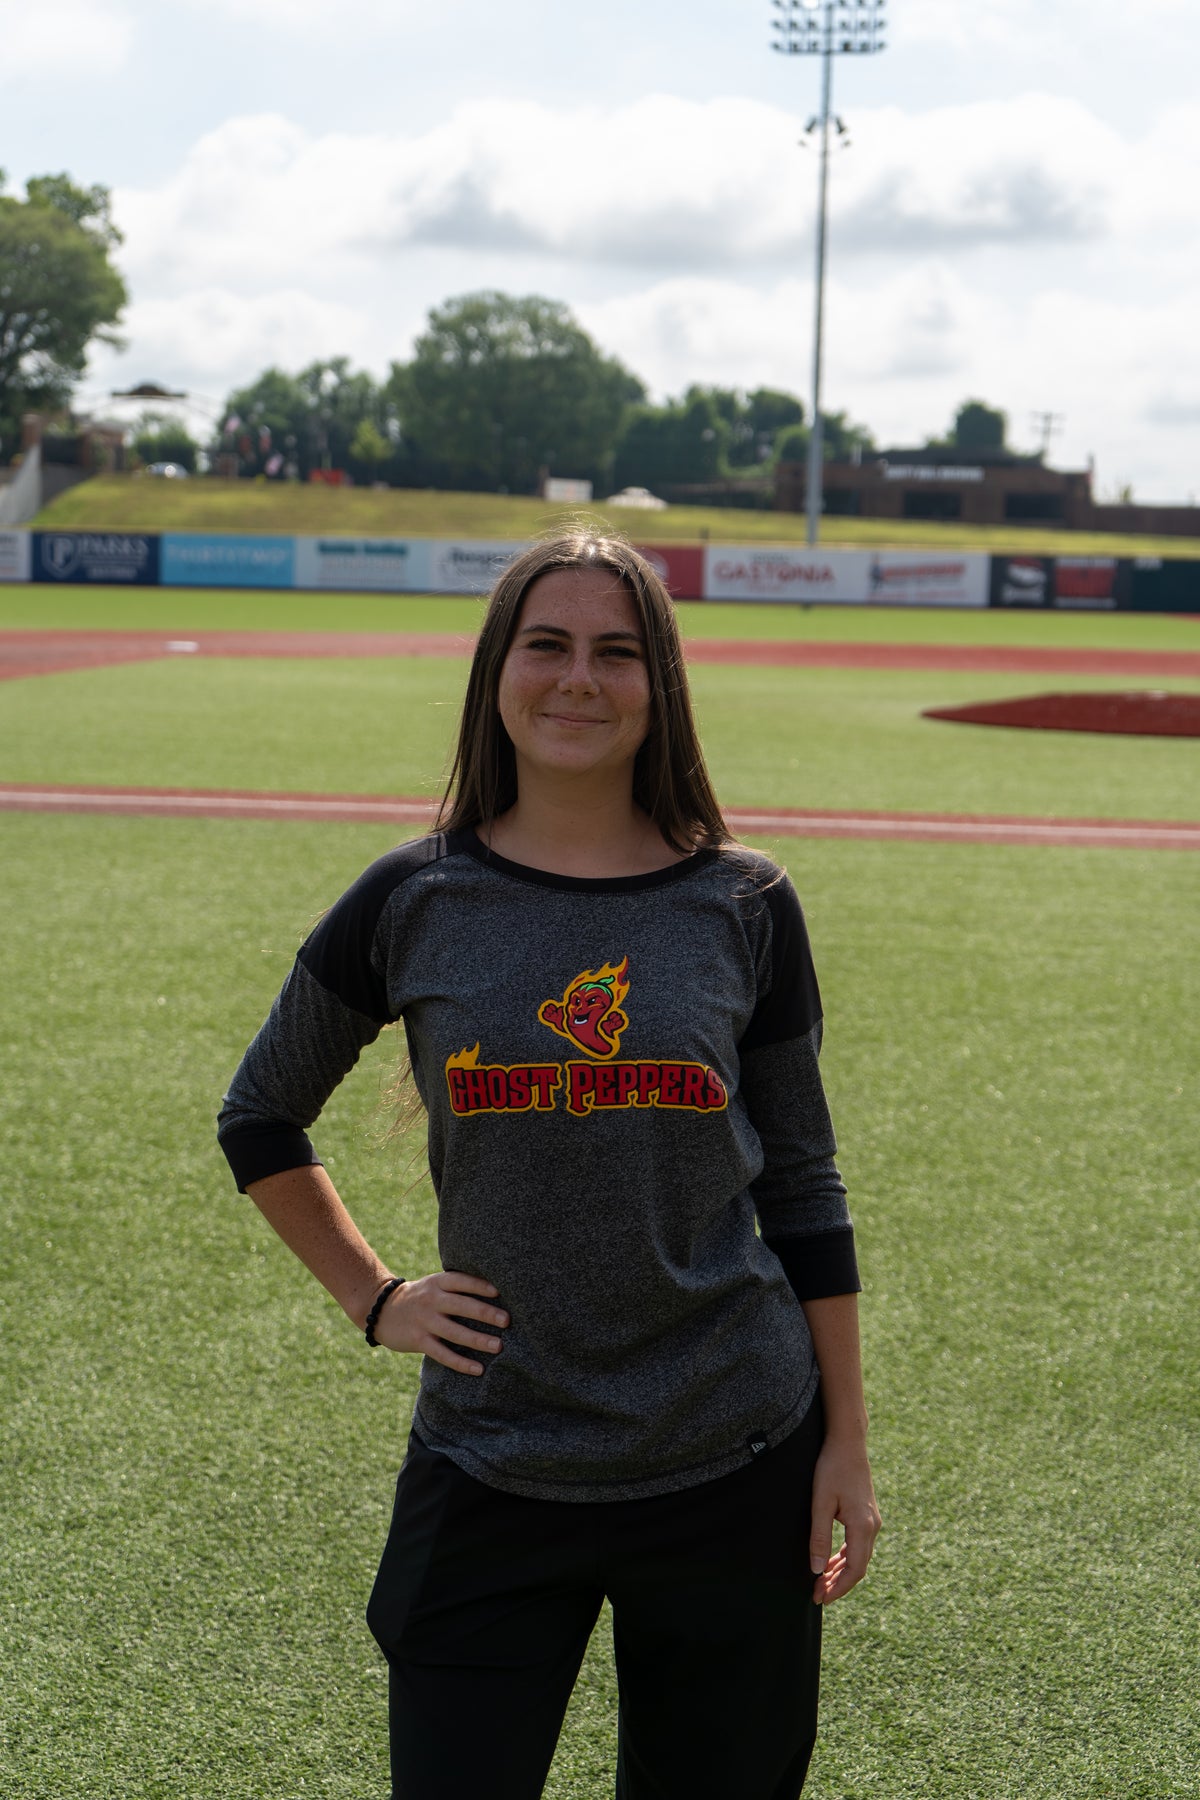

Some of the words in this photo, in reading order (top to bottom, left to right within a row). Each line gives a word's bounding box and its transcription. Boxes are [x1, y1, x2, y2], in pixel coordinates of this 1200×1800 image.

[712, 560, 836, 583] GASTONIA
[447, 1067, 558, 1112] GHOST
[569, 1063, 726, 1113] PEPPERS
